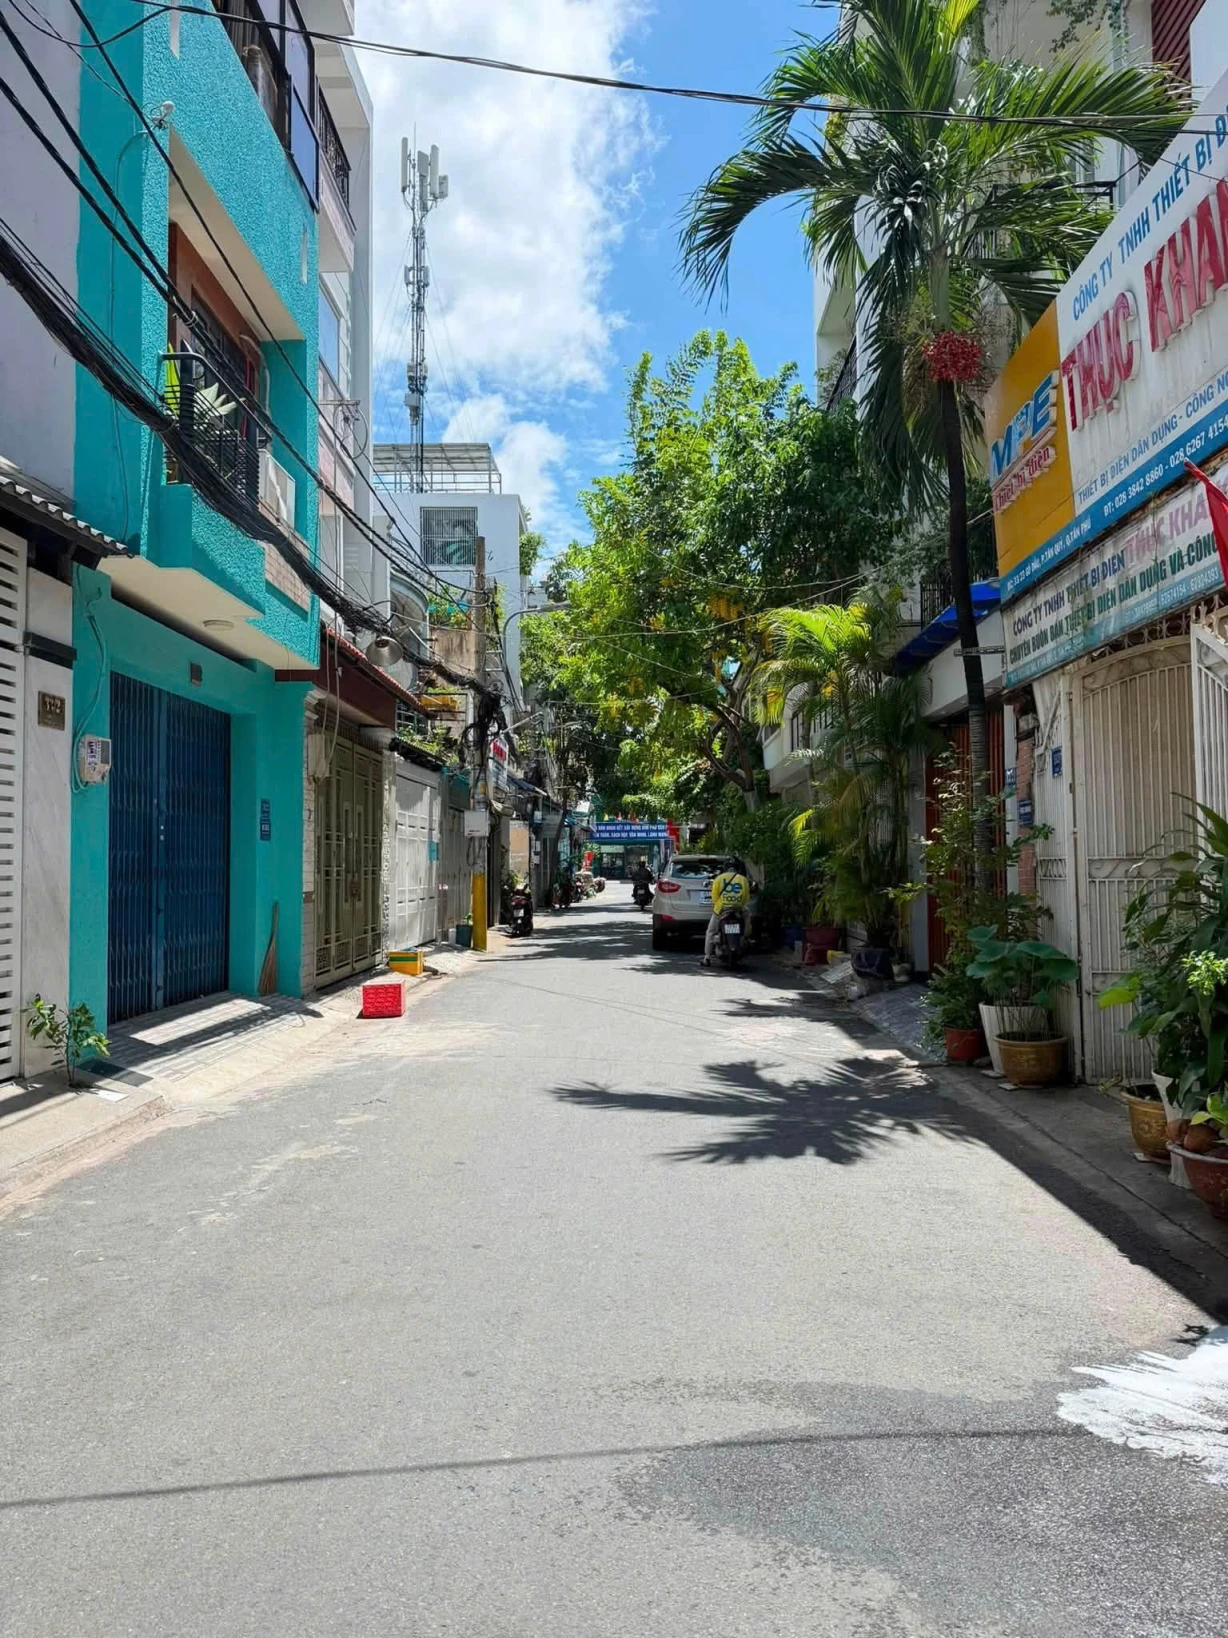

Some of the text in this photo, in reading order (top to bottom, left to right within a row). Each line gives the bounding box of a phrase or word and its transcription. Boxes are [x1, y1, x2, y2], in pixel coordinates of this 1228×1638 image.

[1073, 271, 1099, 321] CÔNG
[1099, 251, 1113, 287] TY
[1118, 206, 1151, 265] TNHH
[1152, 152, 1190, 222] THIẾT
[1195, 131, 1212, 173] BỊ
[1061, 291, 1135, 432] THỤC
[989, 372, 1057, 485] MPE
[1151, 413, 1178, 446] DỤNG
[1185, 384, 1215, 419] CÔNG
[1115, 491, 1127, 508] 028
[1128, 478, 1144, 499] 3842
[1145, 463, 1164, 487] 8860
[1169, 447, 1185, 468] 028
[1185, 431, 1206, 457] 6267
[1169, 547, 1185, 576] VÀ
[1033, 601, 1043, 625] TY
[1043, 591, 1065, 618] TNHH
[723, 878, 743, 894] be
